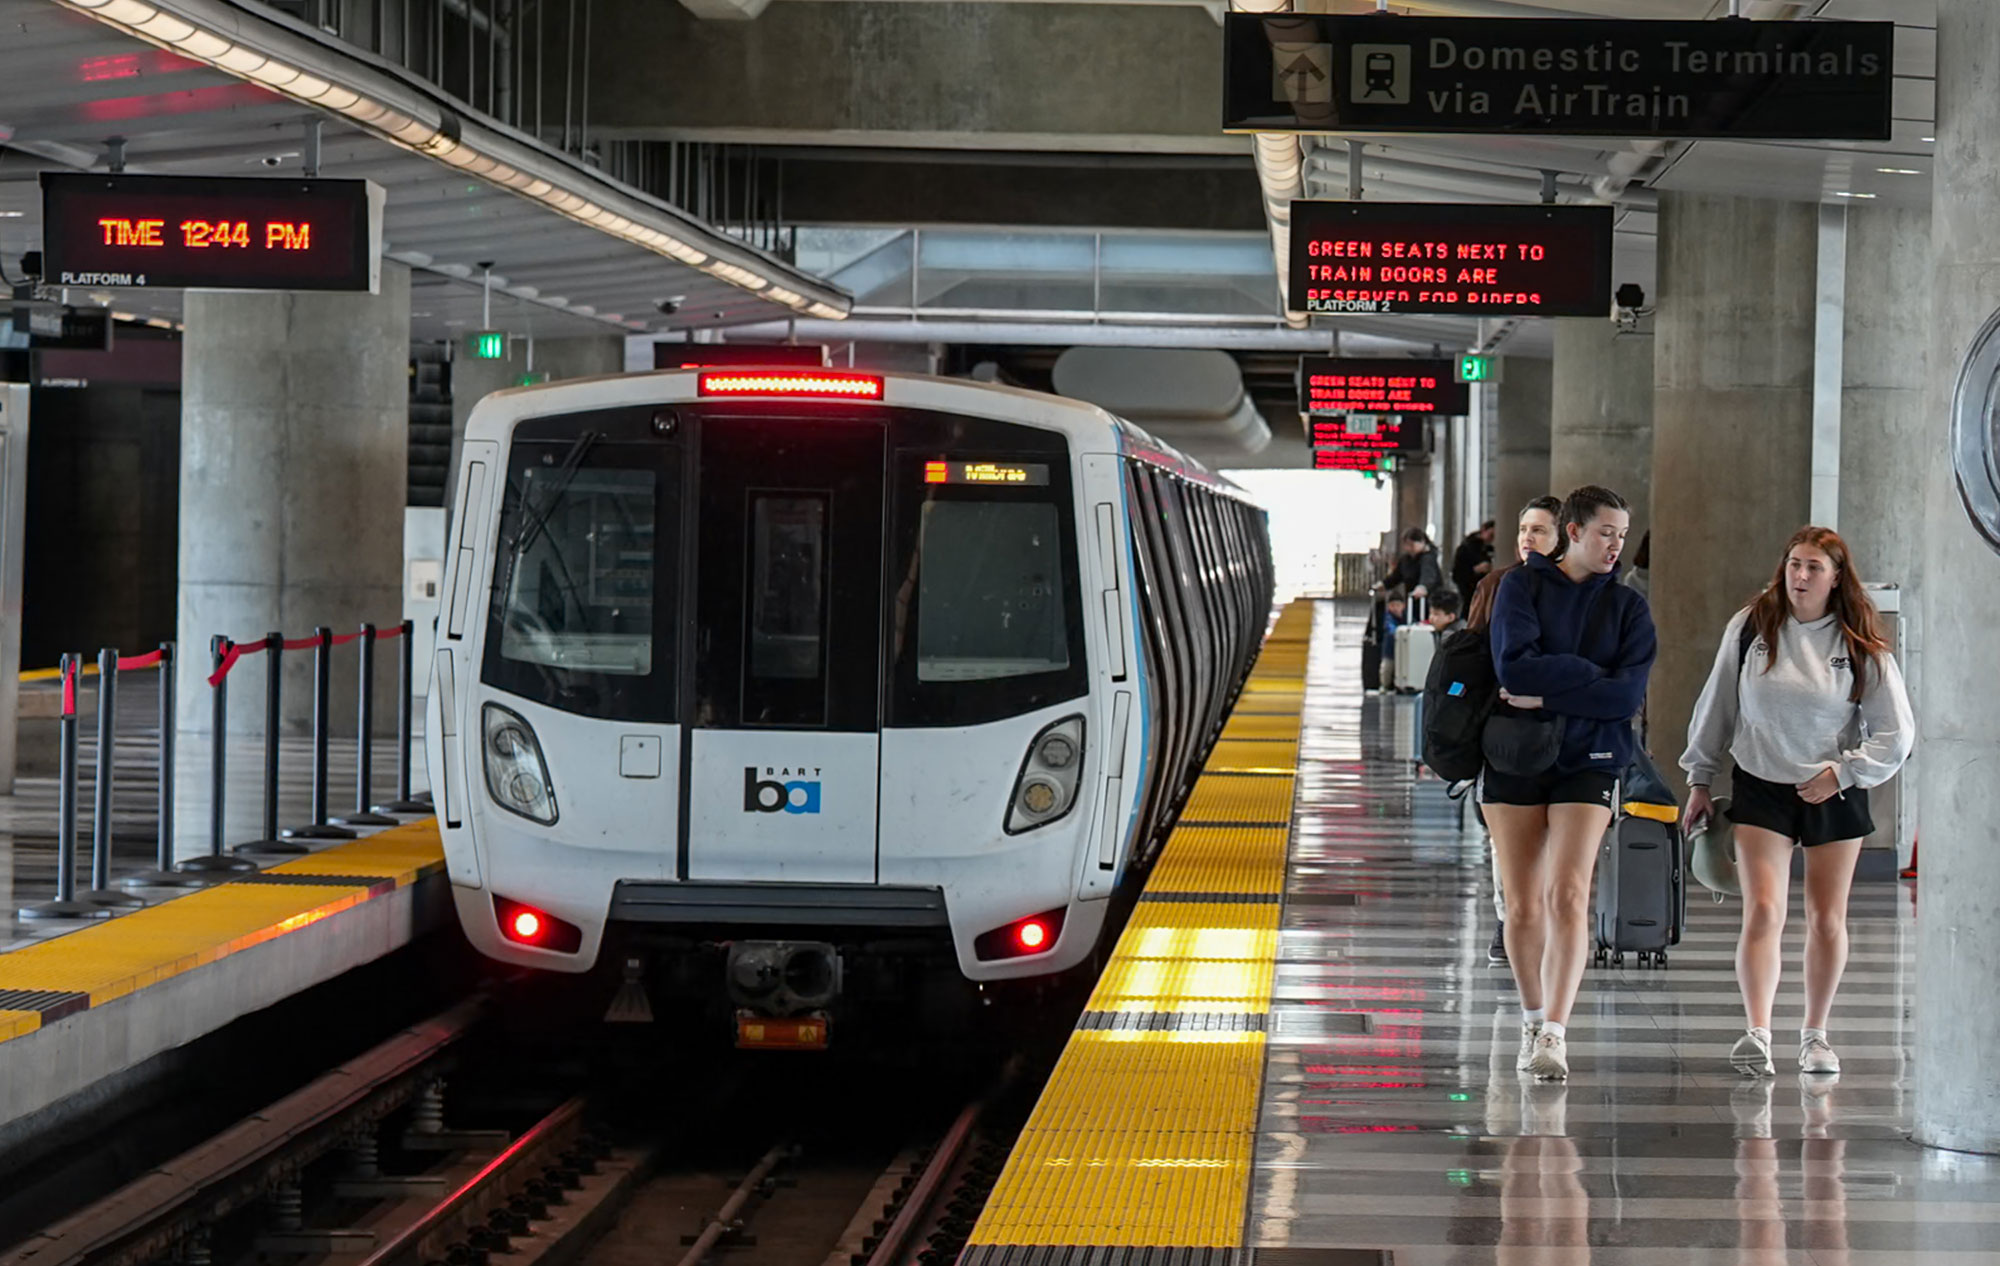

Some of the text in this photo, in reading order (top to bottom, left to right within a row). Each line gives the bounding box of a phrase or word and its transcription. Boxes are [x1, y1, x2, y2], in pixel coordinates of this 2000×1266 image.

[1429, 37, 1880, 76] Domestic Terminals
[1428, 82, 1689, 117] via AirTrain
[98, 218, 310, 250] TIME 12:44 PM
[1308, 240, 1544, 261] GREEN SEATS NEXT TO
[61, 272, 147, 286] PLATFORM 4
[1308, 264, 1498, 285] TRAIN DOORS ARE
[1306, 299, 1391, 312] PLATFORM 2
[1420, 377, 1437, 389] TO
[1309, 388, 1346, 399] TRAIN
[766, 767, 822, 776] BART
